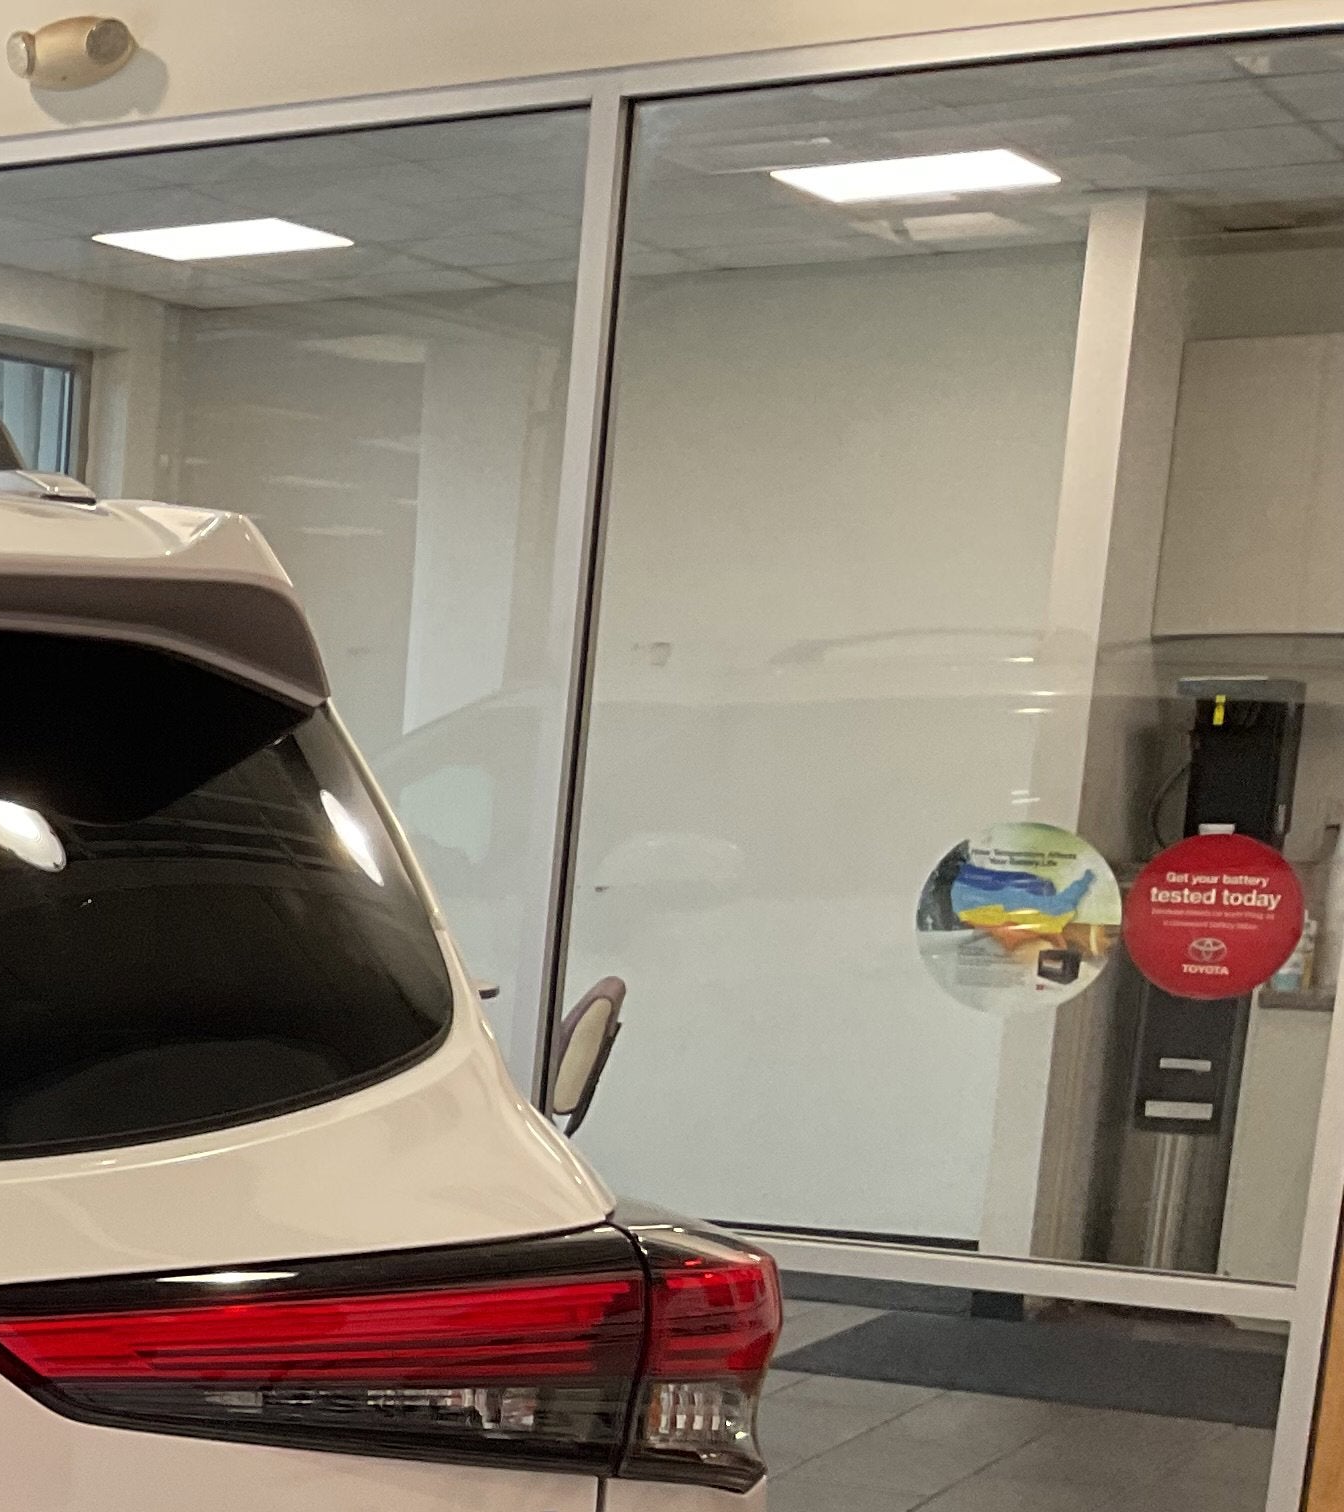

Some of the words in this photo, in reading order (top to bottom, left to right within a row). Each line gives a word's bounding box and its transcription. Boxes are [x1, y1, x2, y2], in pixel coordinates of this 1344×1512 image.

[1166, 871, 1190, 883] Get
[1192, 875, 1219, 886] your
[1222, 874, 1269, 888] battery
[1150, 886, 1216, 905] tested
[1222, 888, 1282, 911] today
[1182, 963, 1229, 976] TOYOTA
